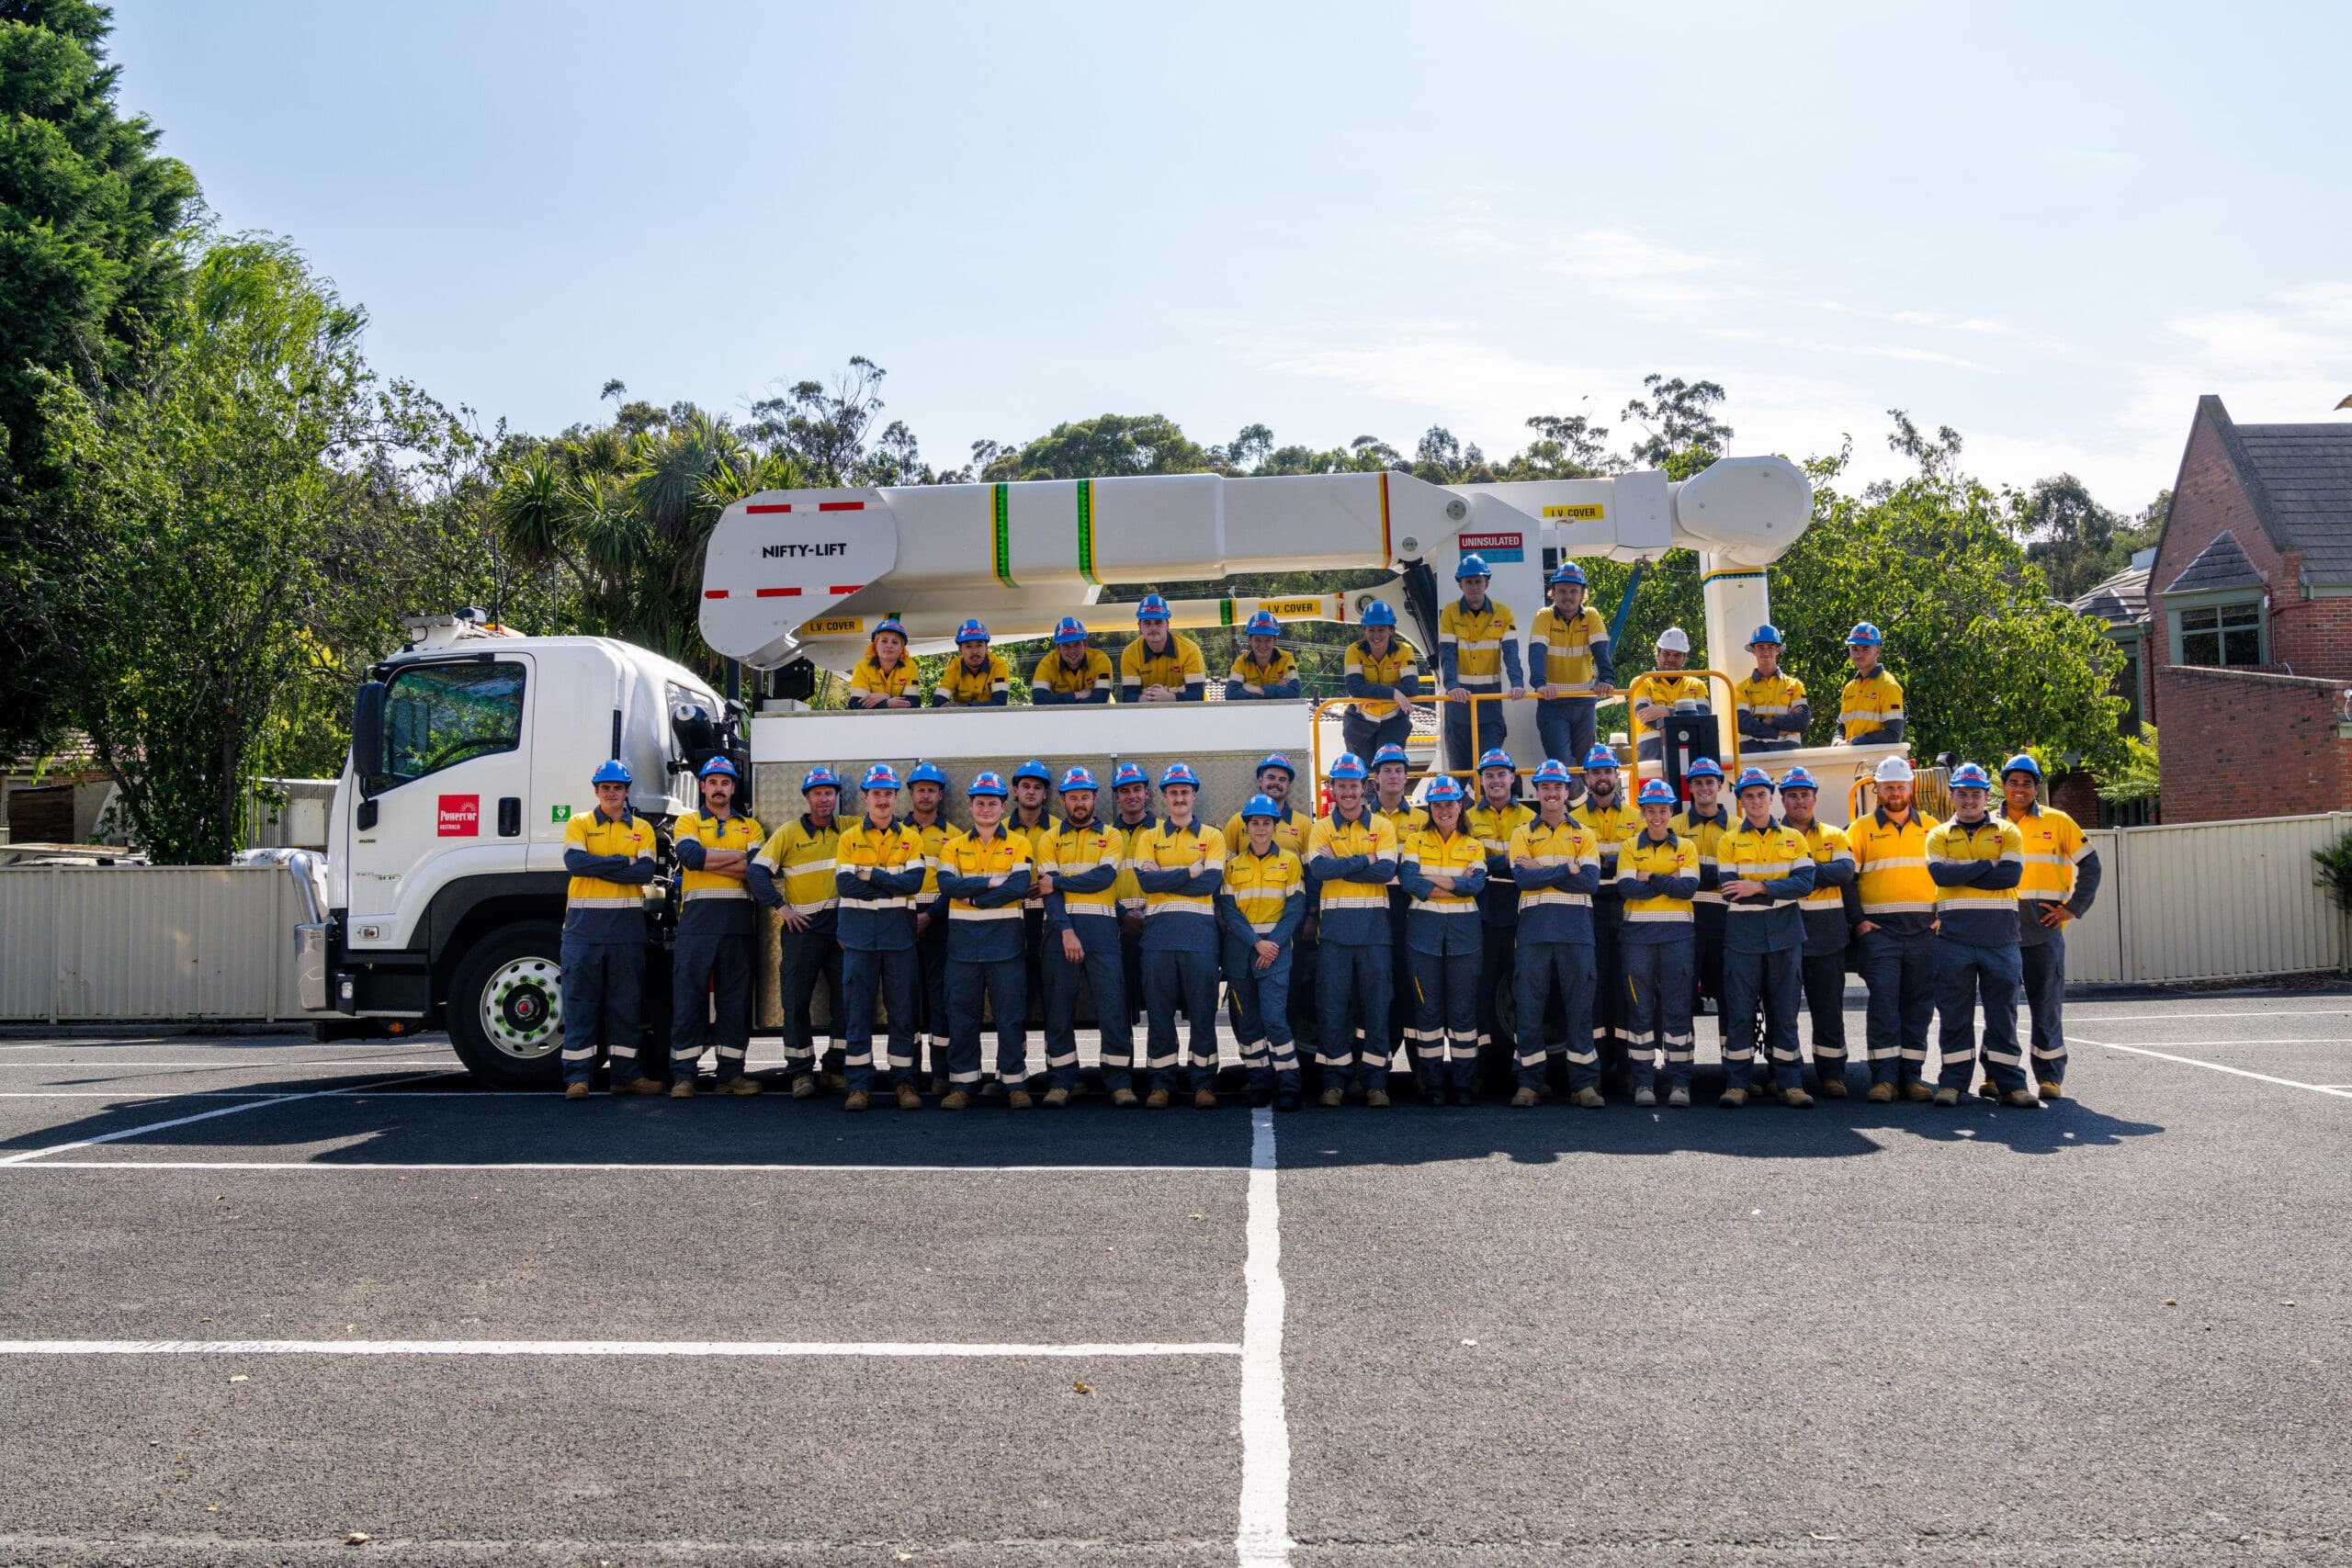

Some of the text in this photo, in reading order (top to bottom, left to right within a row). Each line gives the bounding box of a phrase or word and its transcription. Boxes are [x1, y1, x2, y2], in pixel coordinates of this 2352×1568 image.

[1567, 508, 1595, 517] COVER
[1462, 536, 1520, 547] UNINSULATED
[763, 543, 846, 558] NIFTY-LIFT
[1284, 603, 1313, 614] COVER
[810, 621, 854, 632] L.V. COVER
[440, 809, 477, 821] Powercor
